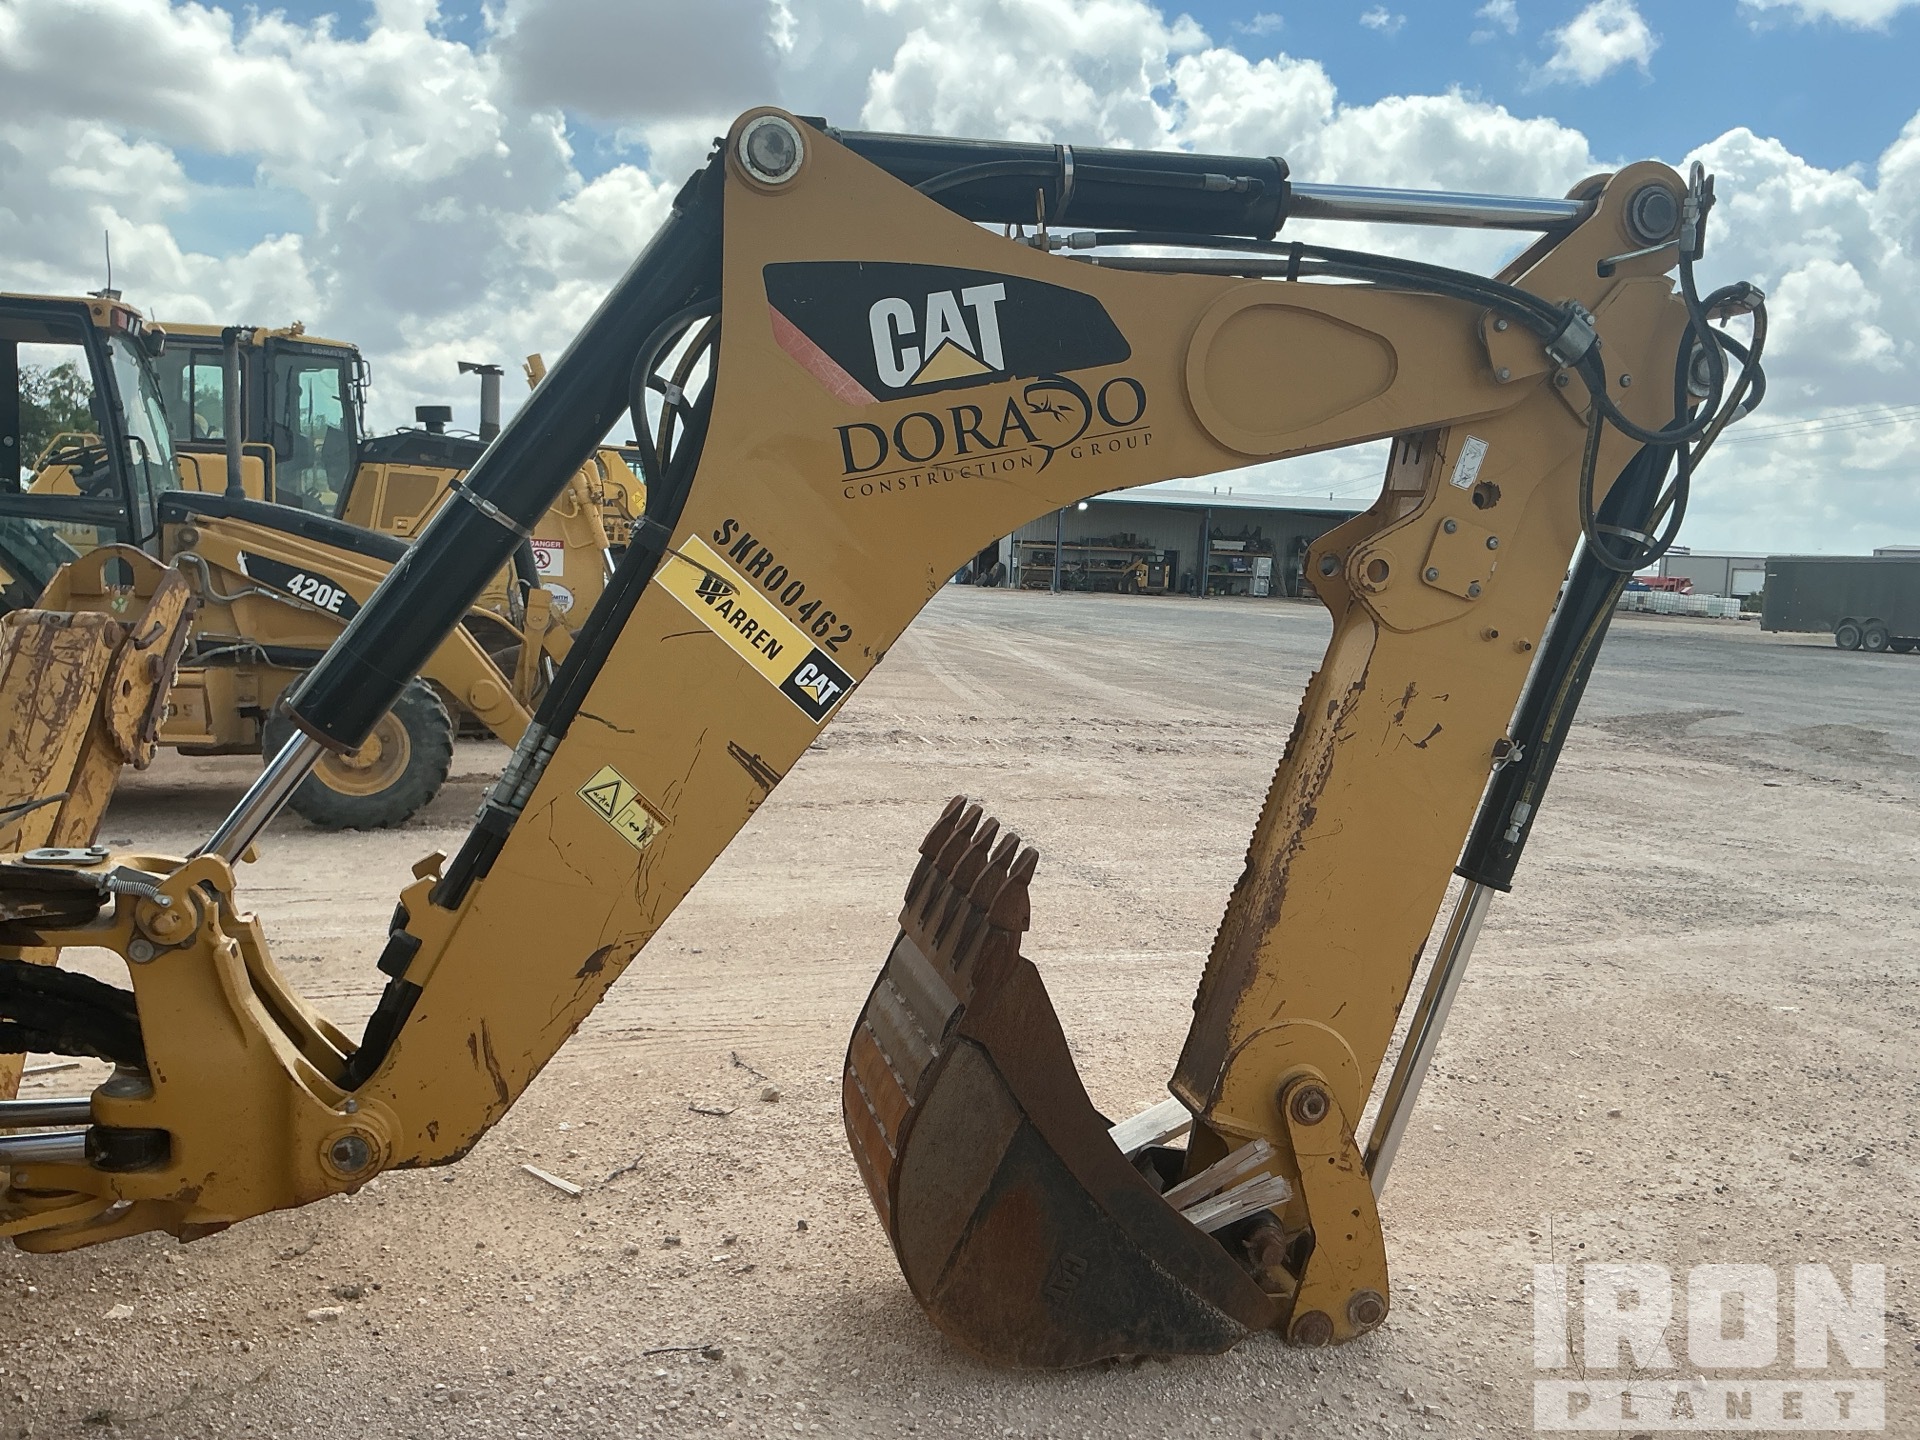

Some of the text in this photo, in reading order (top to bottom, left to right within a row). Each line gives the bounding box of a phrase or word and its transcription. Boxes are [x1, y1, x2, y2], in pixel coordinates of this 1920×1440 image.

[869, 282, 1006, 388] CAT
[833, 374, 1147, 475] DORADO
[844, 432, 1153, 499] CONSTRUCTION GROUP
[286, 573, 347, 613] 420E
[695, 571, 784, 661] WARREN
[713, 518, 853, 653] SKR00462
[794, 662, 841, 706] CAT
[641, 802, 666, 827] WARNING
